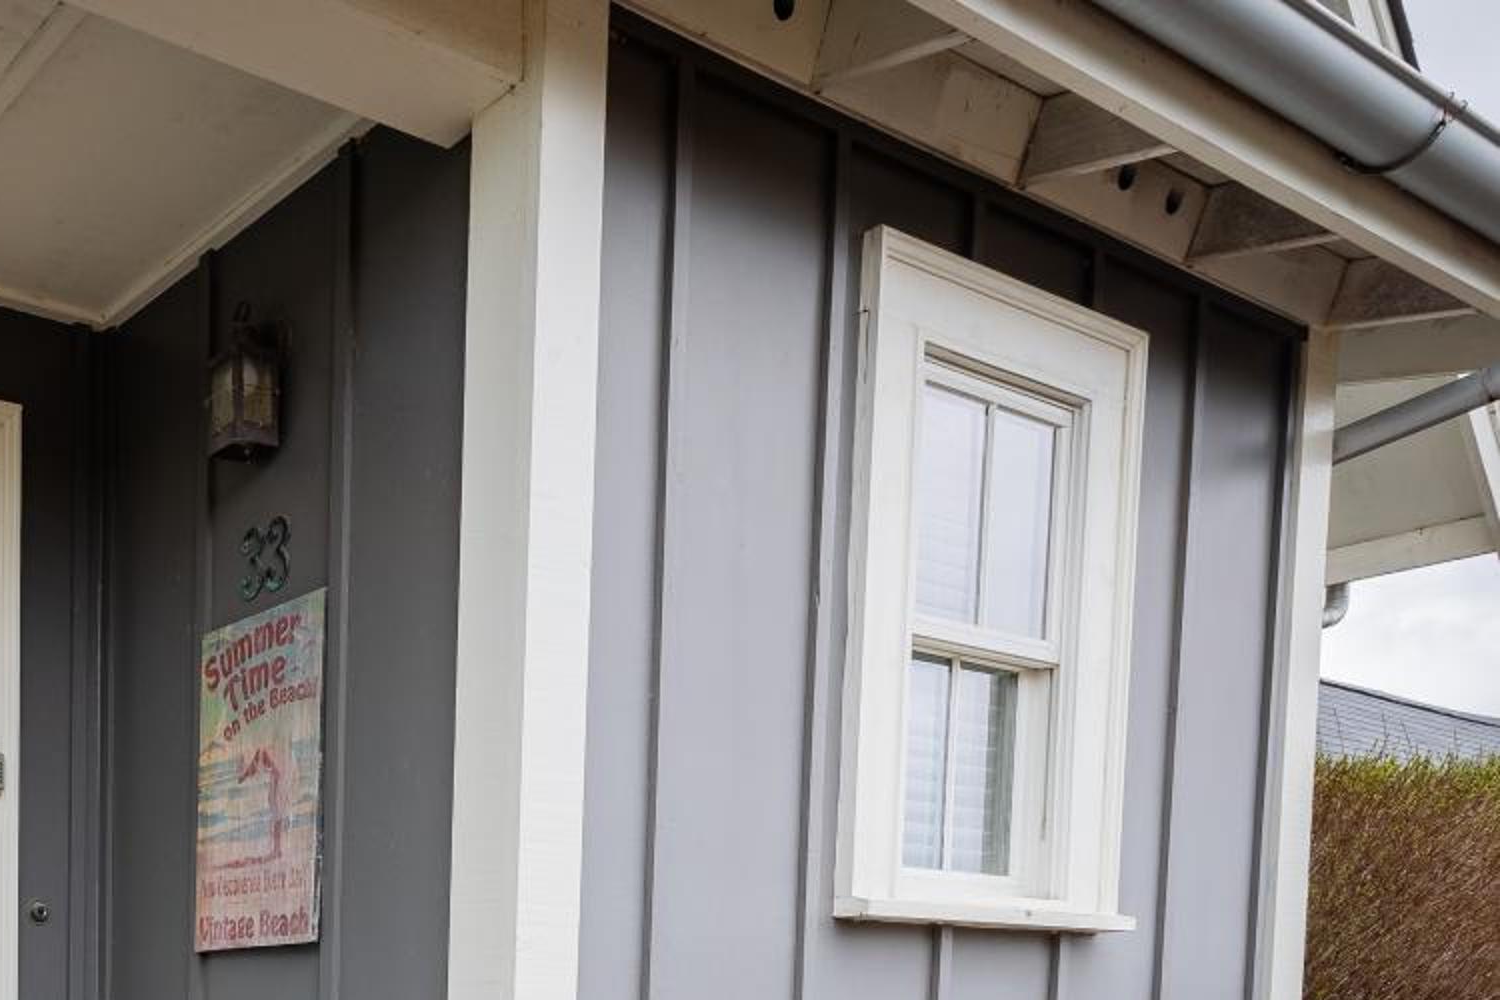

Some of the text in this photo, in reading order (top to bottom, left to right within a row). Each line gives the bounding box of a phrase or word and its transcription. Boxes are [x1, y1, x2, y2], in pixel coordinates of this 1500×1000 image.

[204, 613, 303, 692] Summer
[223, 655, 286, 711] Time
[223, 719, 241, 741] on
[244, 700, 266, 724] the
[199, 905, 309, 941] Vintage Beach
